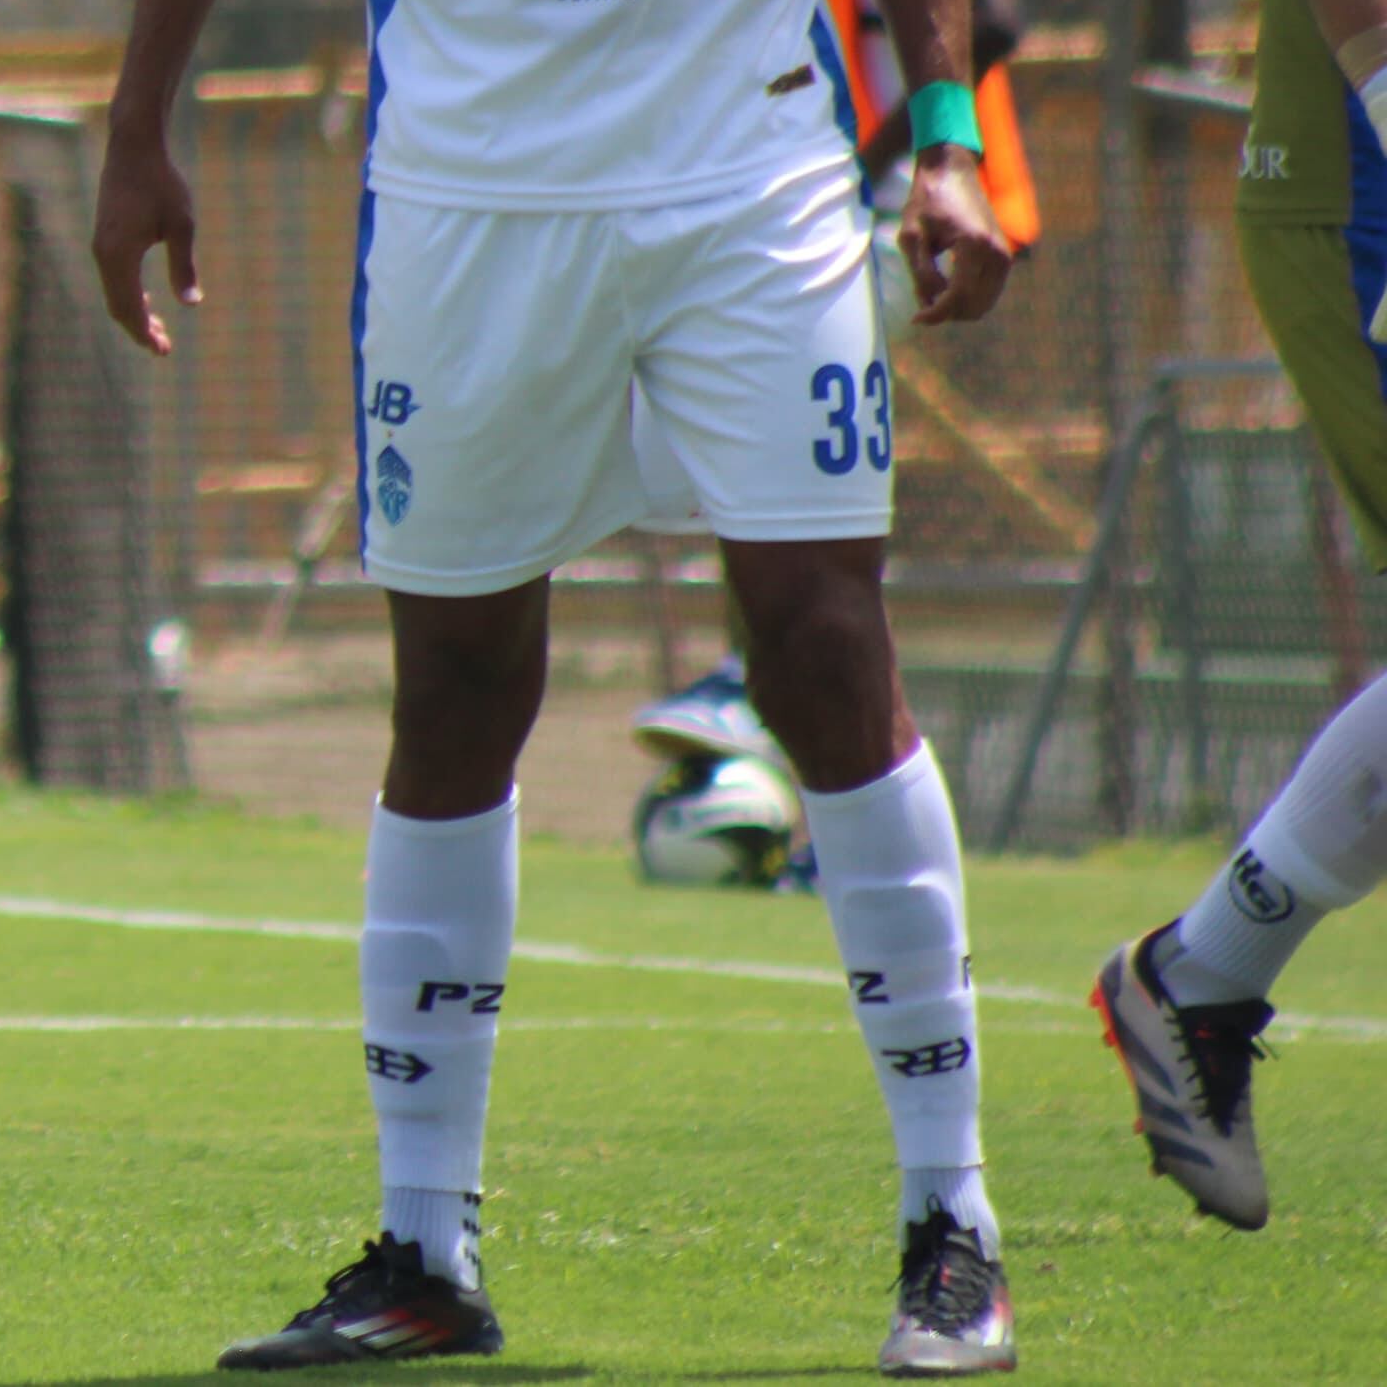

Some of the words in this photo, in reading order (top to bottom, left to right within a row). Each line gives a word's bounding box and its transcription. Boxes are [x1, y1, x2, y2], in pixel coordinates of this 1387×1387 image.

[367, 380, 412, 426] JB
[811, 361, 892, 476] 33
[416, 980, 505, 1015] PZ
